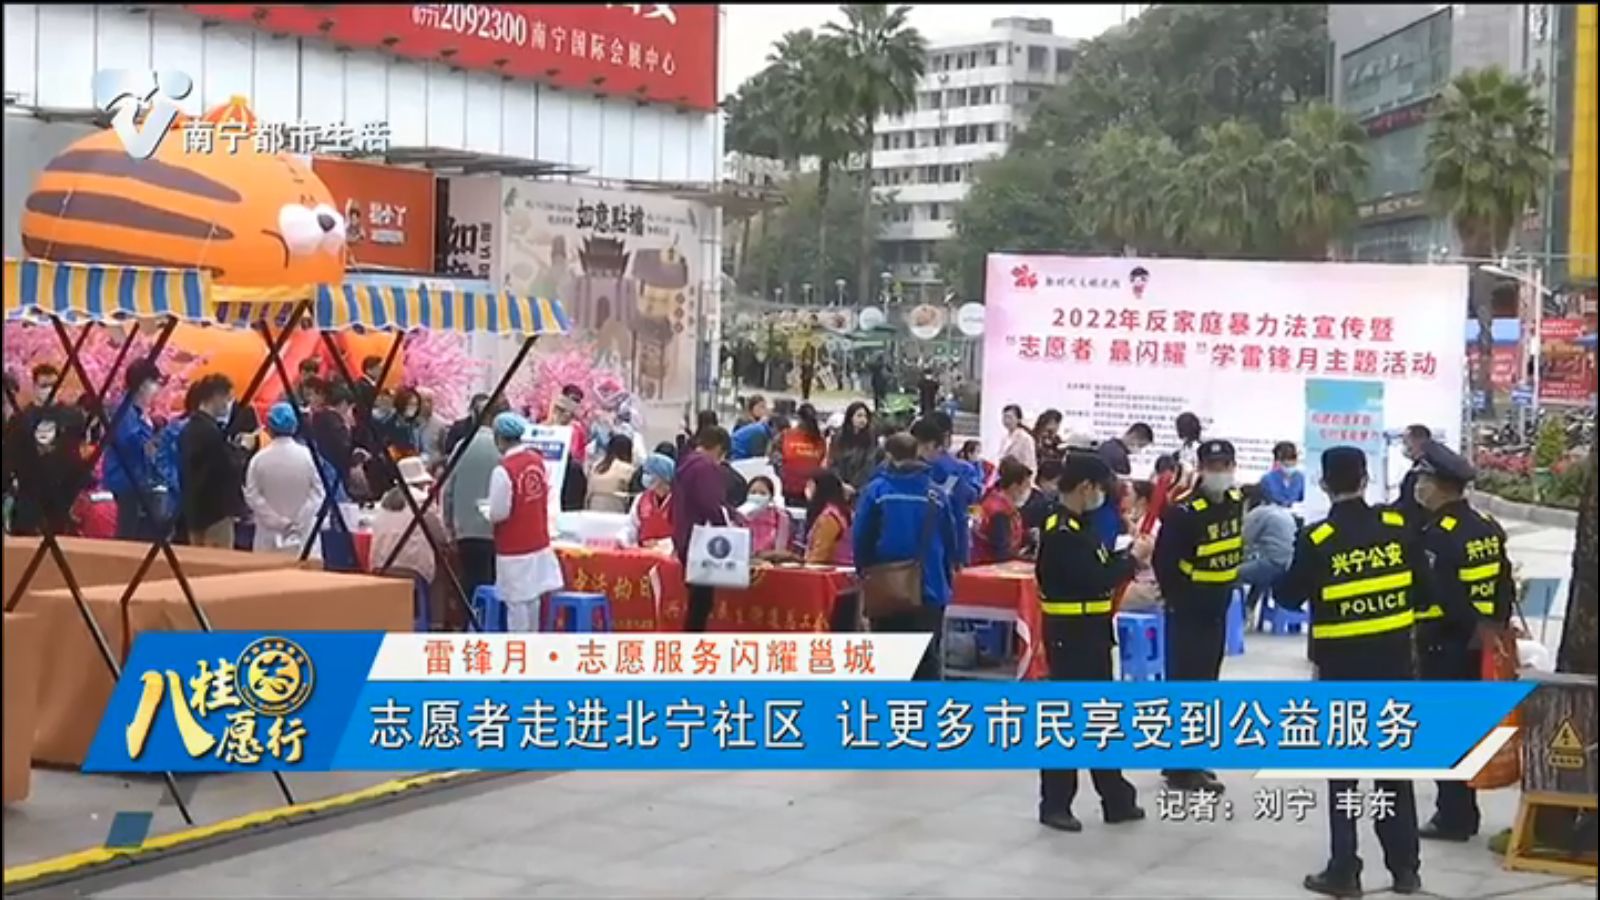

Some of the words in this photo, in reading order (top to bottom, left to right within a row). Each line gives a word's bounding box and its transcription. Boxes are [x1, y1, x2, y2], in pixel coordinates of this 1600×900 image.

[531, 20, 677, 76] 南宁国际会展中心
[1052, 307, 1395, 343] 2022年反家庭暴力法宣传暨
[1331, 542, 1403, 576] 兴宁公安
[1340, 592, 1407, 616] POLICE
